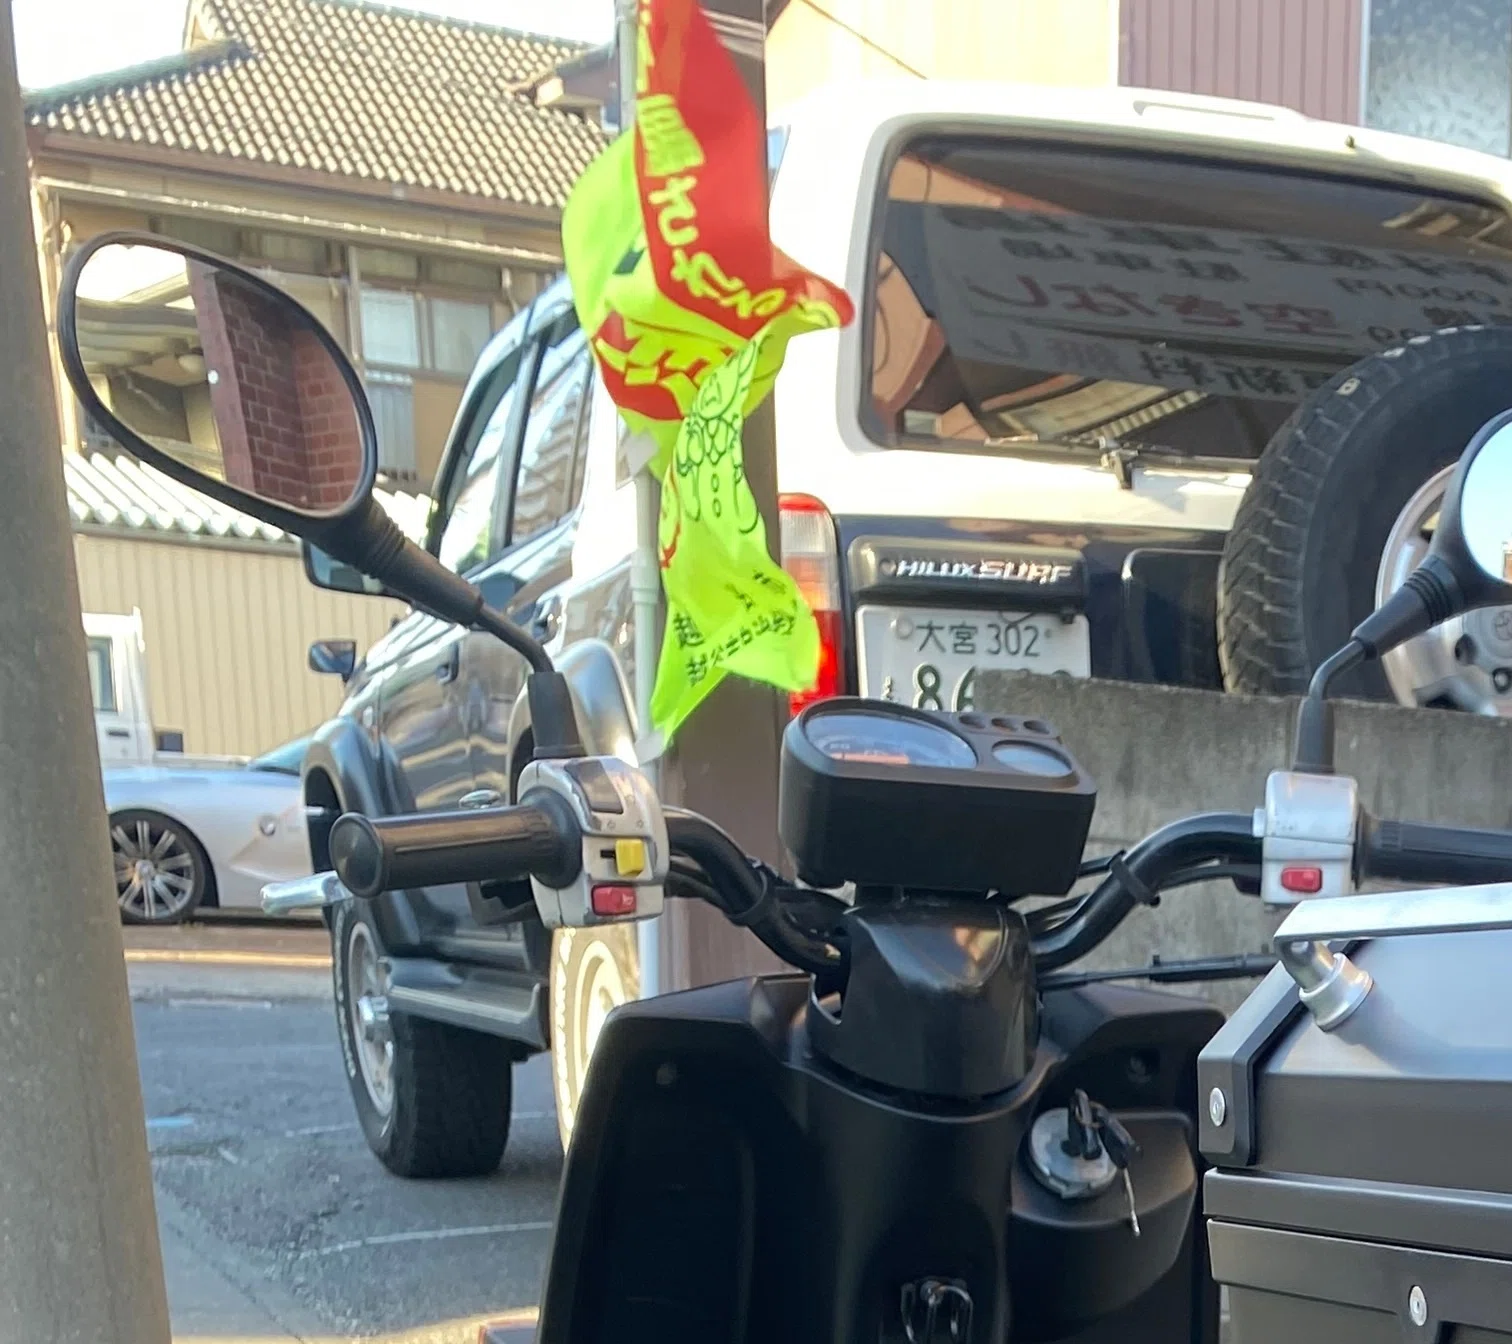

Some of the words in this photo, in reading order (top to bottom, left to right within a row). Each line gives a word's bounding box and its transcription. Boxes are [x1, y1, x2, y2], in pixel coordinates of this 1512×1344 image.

[897, 558, 976, 578] HILUX
[978, 559, 1073, 586] SURF
[915, 620, 978, 655] 大宮
[985, 622, 1040, 658] 302
